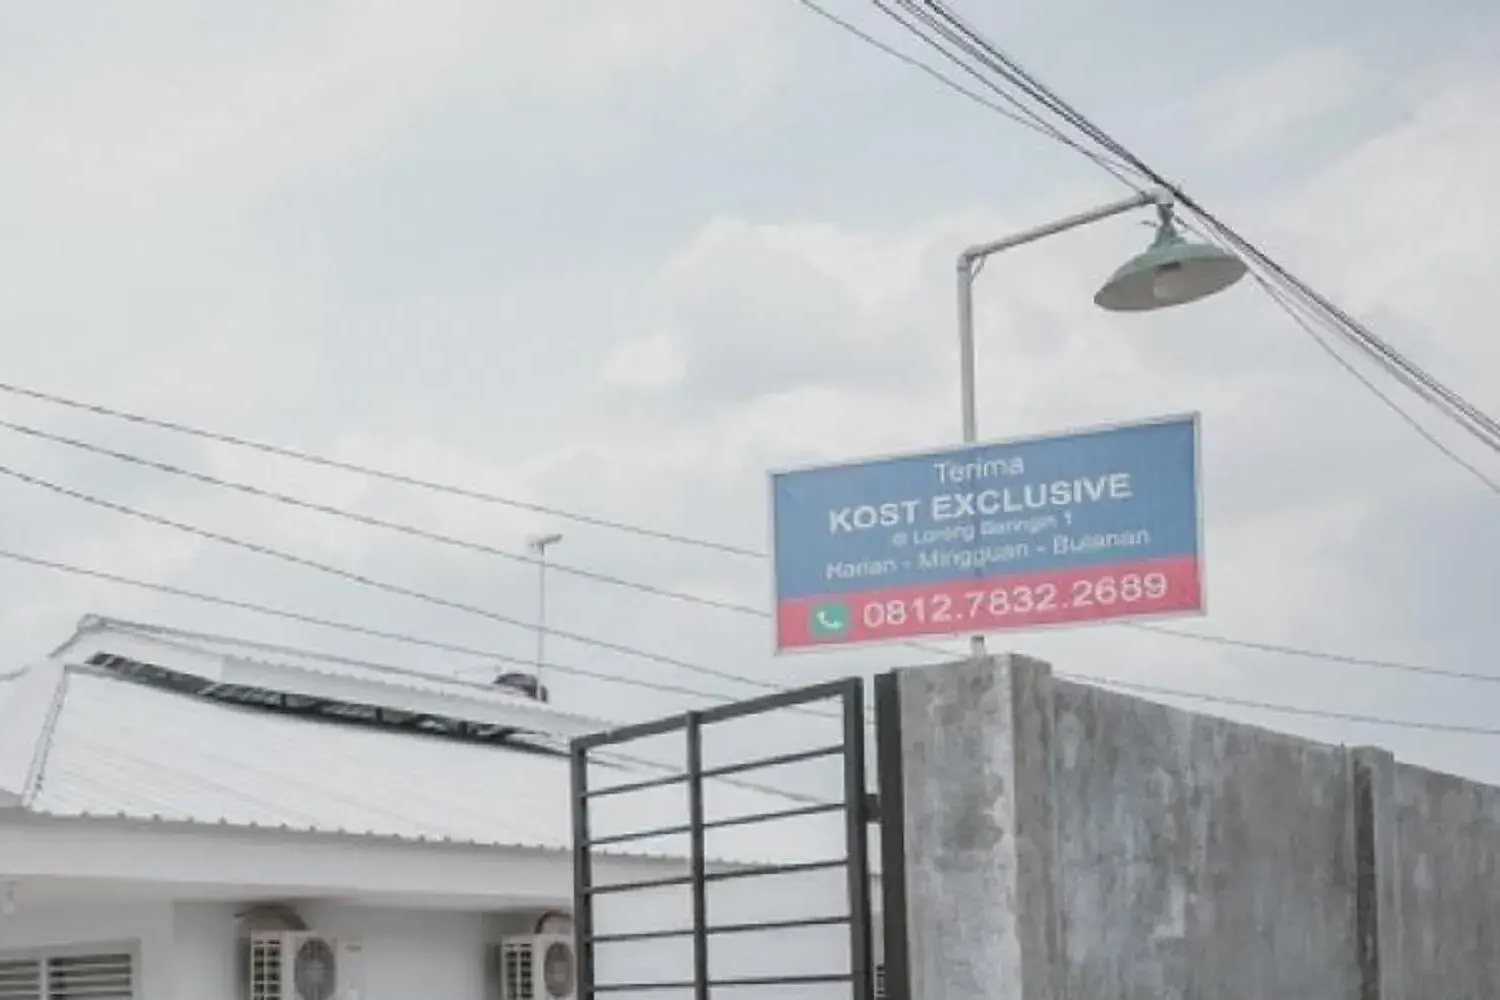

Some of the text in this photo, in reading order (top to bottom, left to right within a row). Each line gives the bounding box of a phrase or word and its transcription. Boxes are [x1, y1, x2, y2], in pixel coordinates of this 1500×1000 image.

[933, 457, 1025, 485] Terima
[828, 472, 1133, 535] KOST EXCLUSIVE
[917, 543, 1029, 571] Mingguan
[1053, 528, 1151, 556] Bulanan
[862, 571, 1168, 629] 0812.7832.2689
